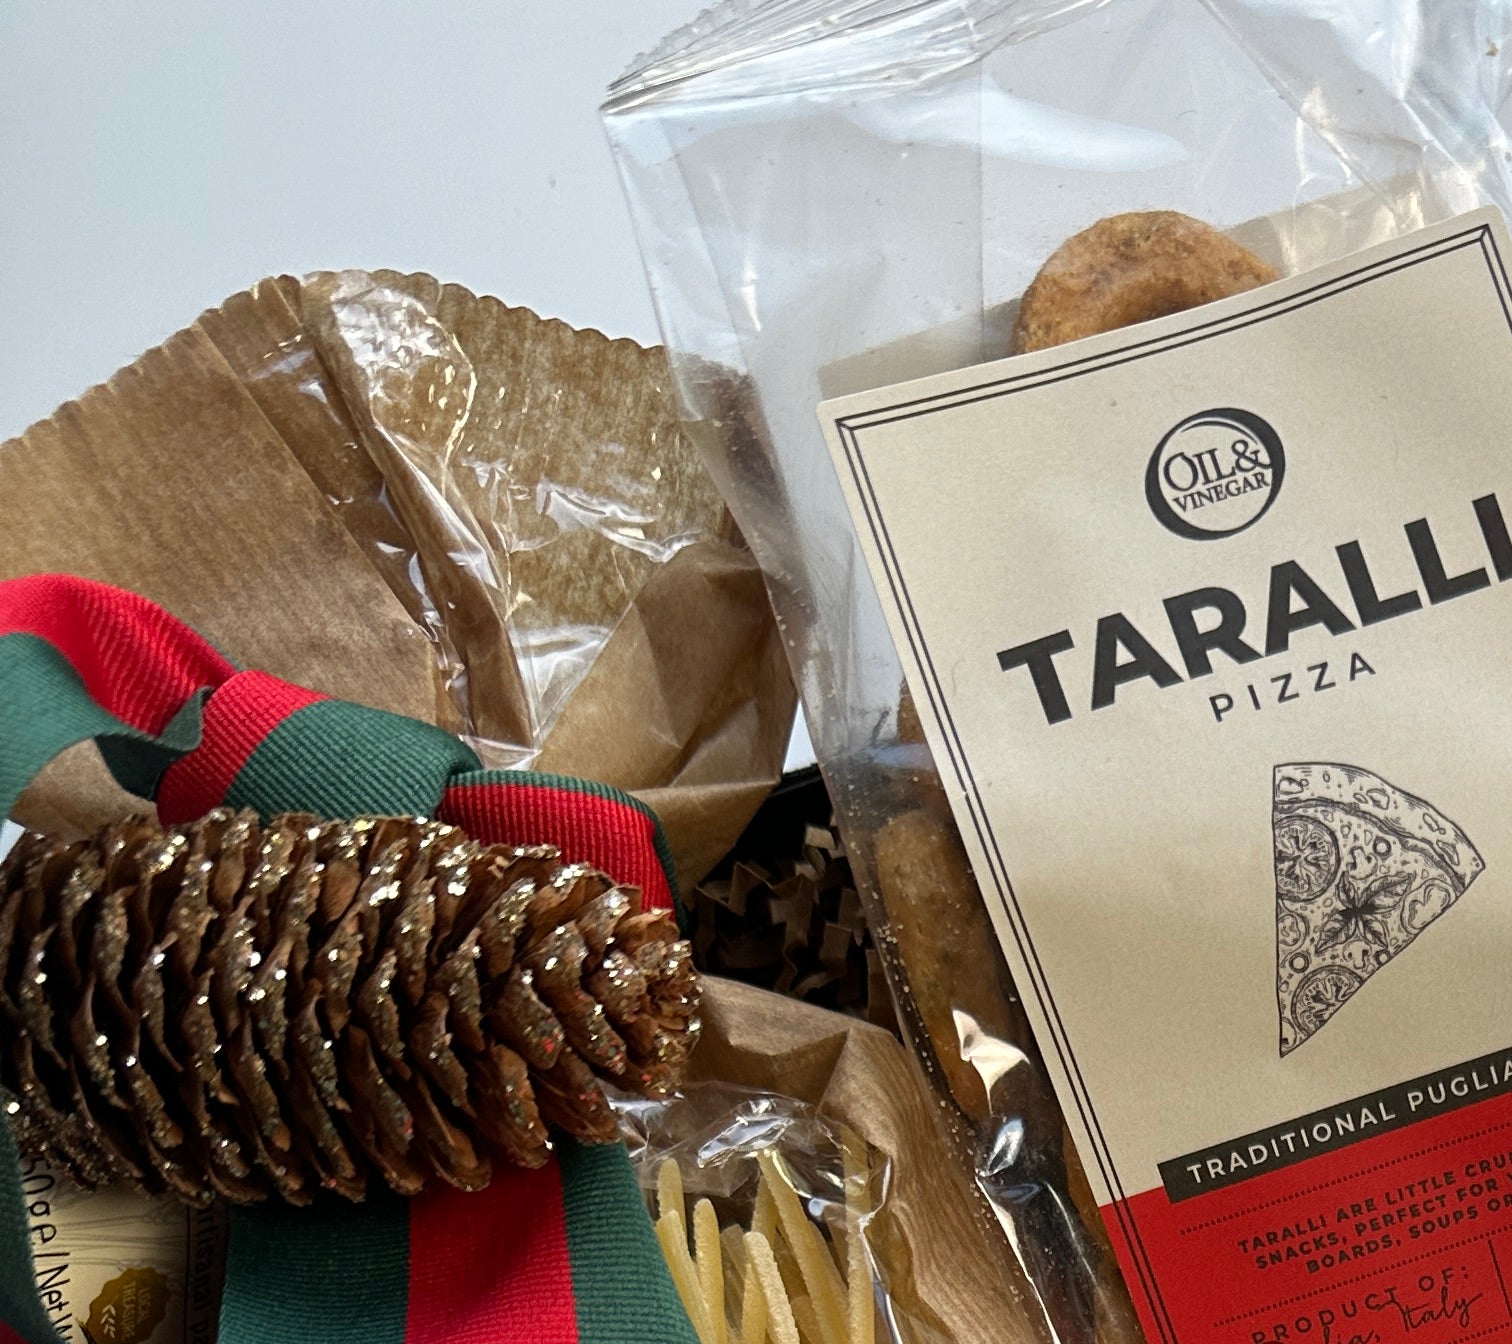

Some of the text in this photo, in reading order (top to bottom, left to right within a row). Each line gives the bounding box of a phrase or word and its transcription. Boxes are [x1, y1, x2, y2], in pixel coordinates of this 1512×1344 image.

[1172, 472, 1270, 513] VINEGAR
[1209, 651, 1376, 722] PIZZA
[1187, 1101, 1396, 1184] TRADITIONAL
[1237, 1215, 1327, 1254] TARALLI
[1336, 1198, 1378, 1224] ARE
[1384, 1171, 1456, 1206] LITTLE
[1255, 1231, 1348, 1270] SNACKS,
[1354, 1193, 1448, 1237] PERFECT
[1456, 1177, 1499, 1202] FOR
[1306, 1234, 1402, 1275] BOARDS,
[1408, 1205, 1479, 1240] SOUPS
[119, 1280, 136, 1344] TREASURE
[1376, 1285, 1484, 1333] Italy
[1418, 1265, 1469, 1293] OF:
